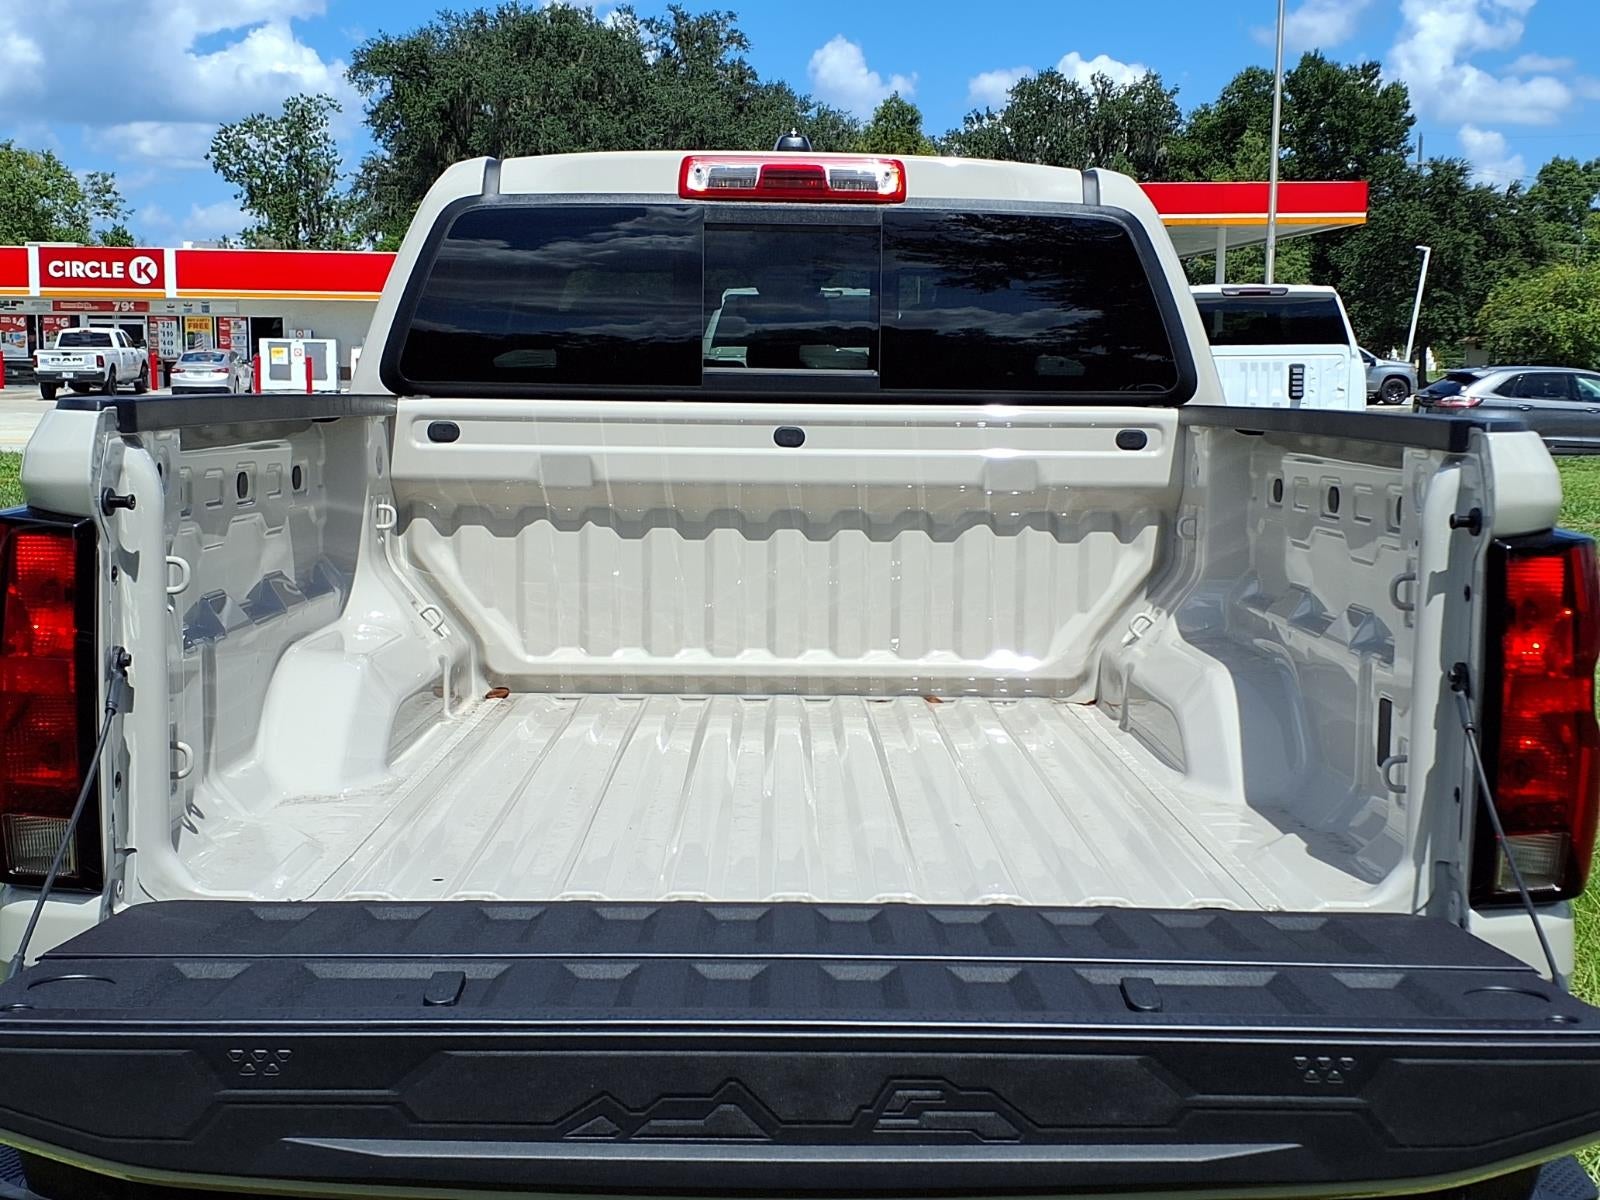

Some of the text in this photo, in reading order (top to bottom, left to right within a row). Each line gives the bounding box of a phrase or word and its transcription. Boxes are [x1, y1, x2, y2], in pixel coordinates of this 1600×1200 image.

[48, 259, 157, 283] CIRCLE K
[188, 322, 209, 330] FREE
